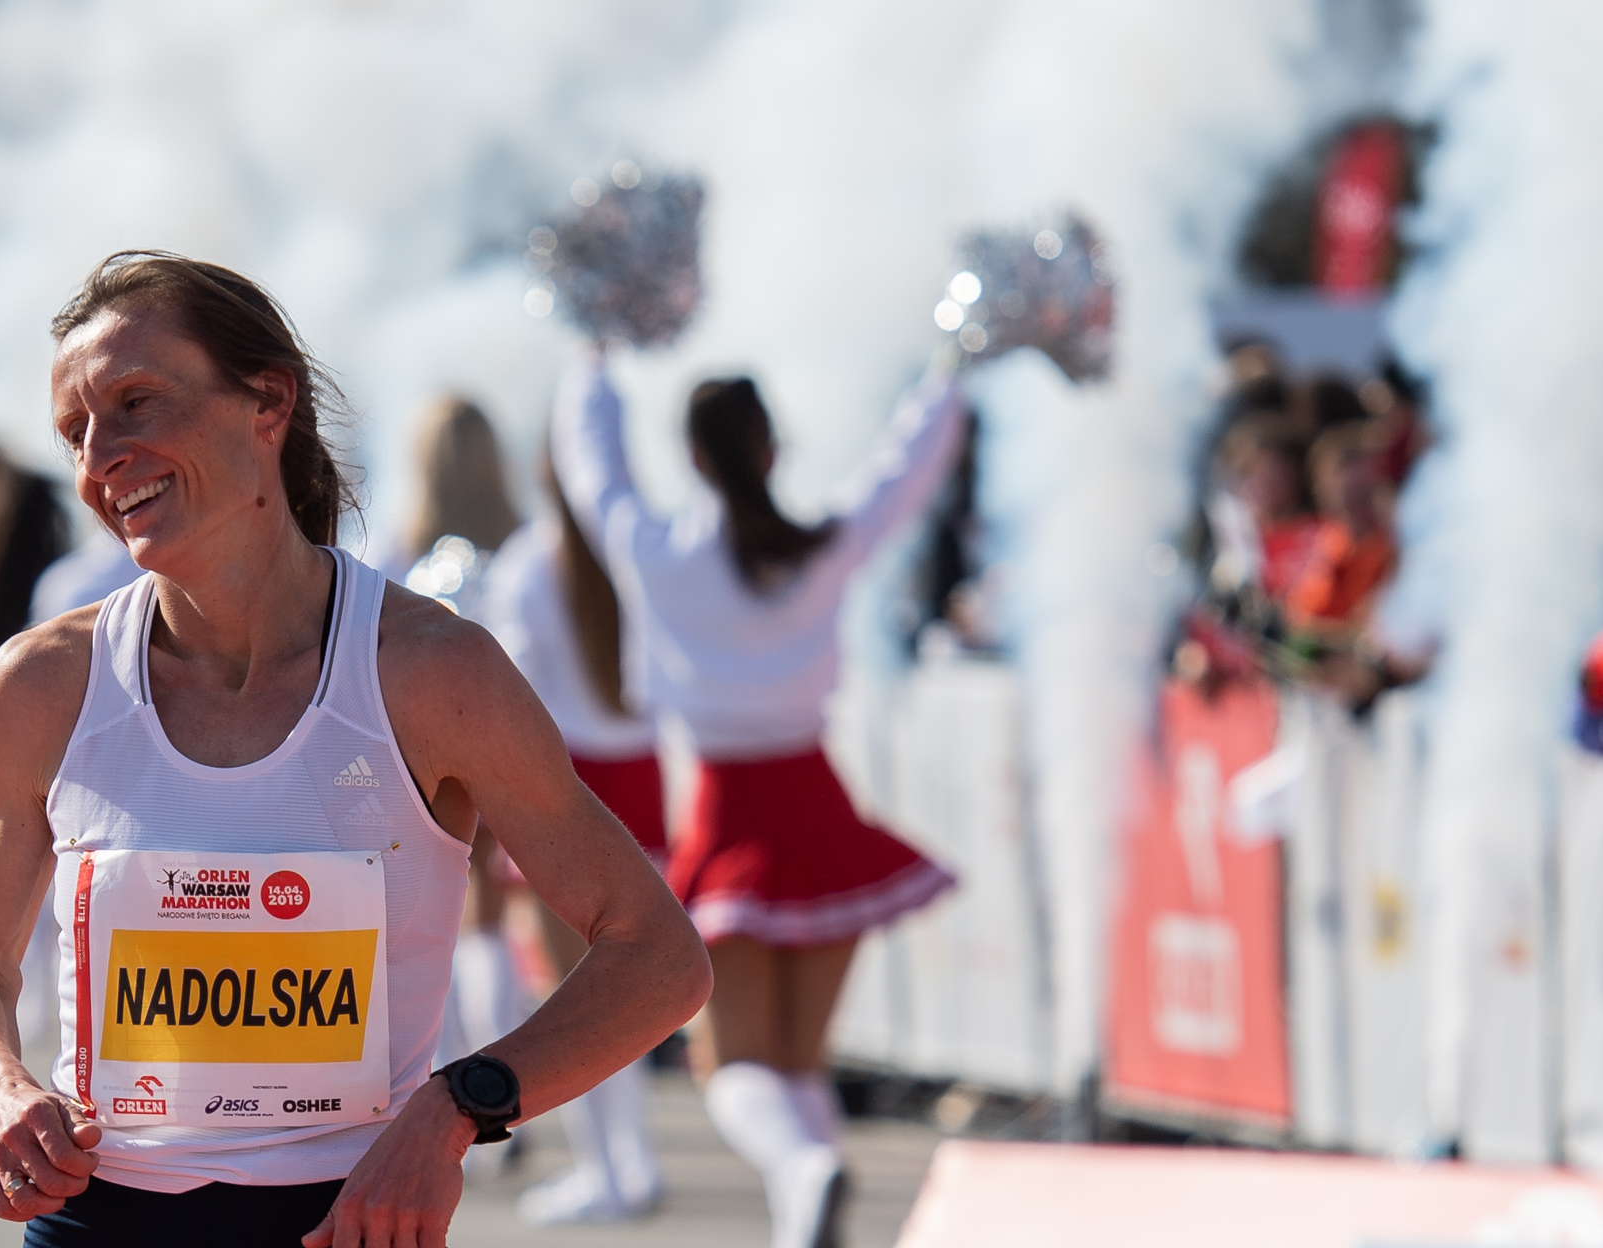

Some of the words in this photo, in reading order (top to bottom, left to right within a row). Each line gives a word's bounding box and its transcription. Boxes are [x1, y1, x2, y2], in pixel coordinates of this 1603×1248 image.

[333, 775, 380, 788] adidas
[197, 869, 249, 883] ORLEN
[181, 884, 250, 896] WARSAW
[267, 885, 304, 895] 14.04.
[77, 892, 87, 922] ELITE
[161, 897, 250, 909] MARATHON
[267, 895, 304, 906] 2019
[157, 911, 195, 919] NARODOWE
[116, 967, 360, 1027] NADOLSKA
[78, 1047, 87, 1077] 35:00
[78, 1079, 86, 1092] do
[115, 1100, 164, 1113] ORLEN
[222, 1099, 260, 1112] asics
[282, 1098, 342, 1113] OSHEE
